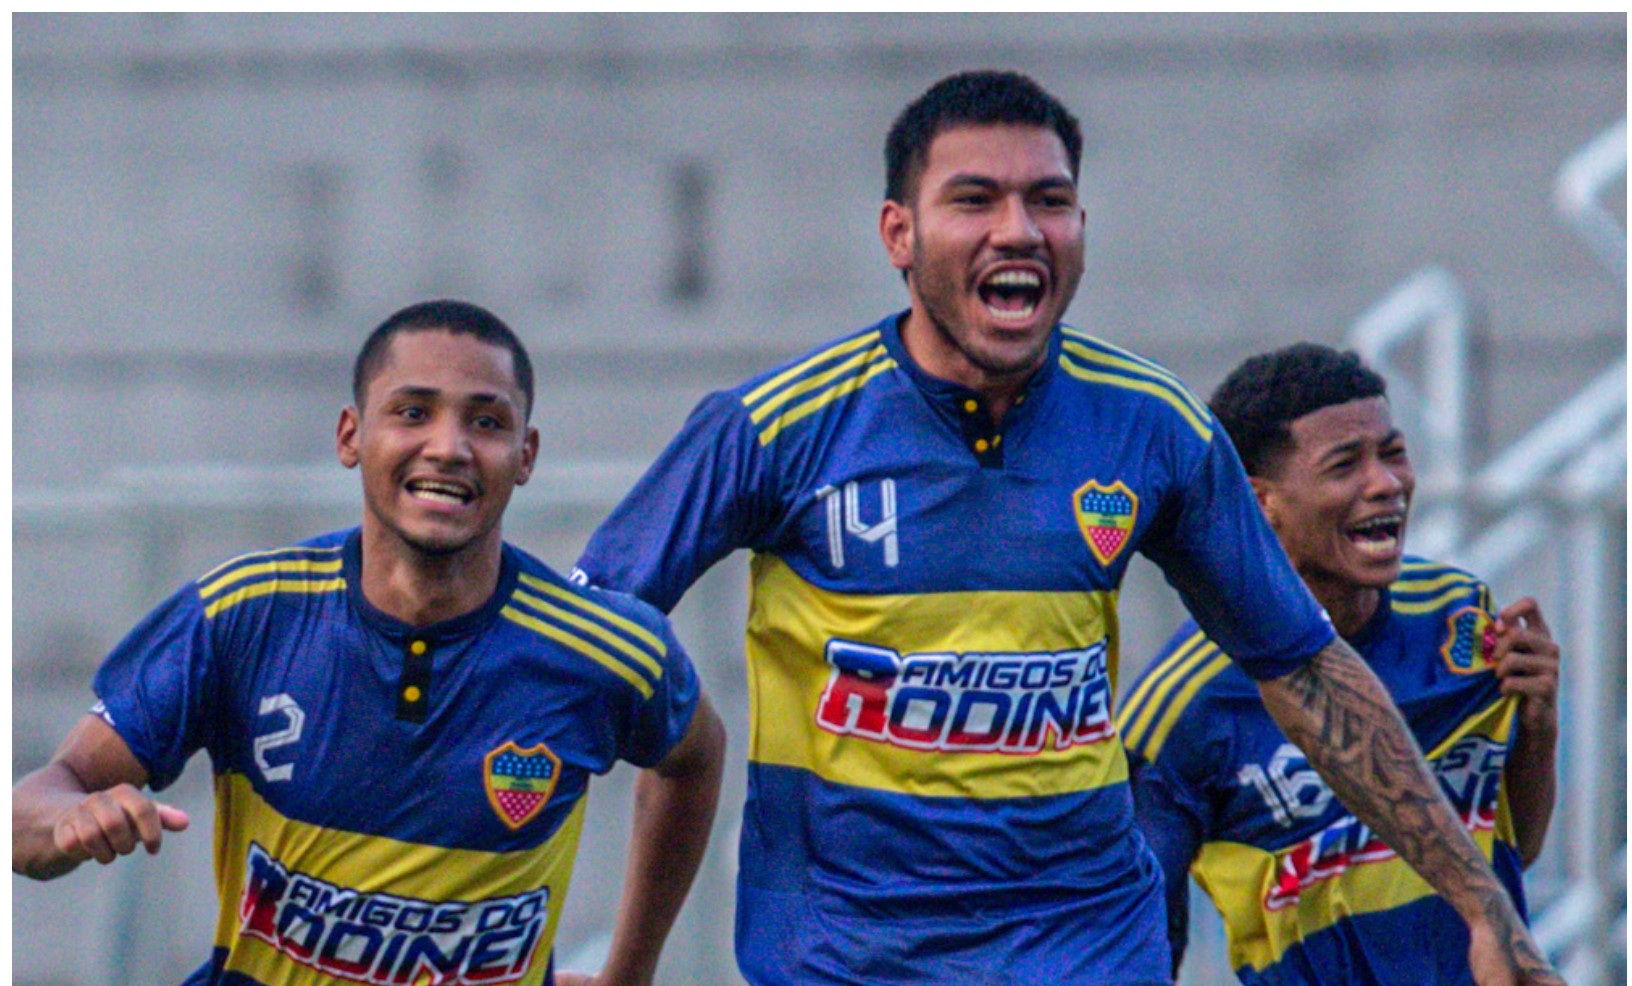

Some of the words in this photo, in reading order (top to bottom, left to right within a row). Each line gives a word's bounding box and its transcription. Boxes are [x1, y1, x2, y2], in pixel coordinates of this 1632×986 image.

[816, 477, 898, 568] 14
[902, 656, 1078, 690] AMIGOS
[253, 693, 306, 782] 2
[1237, 742, 1334, 828] 16
[242, 848, 542, 985] RODINEI
[288, 879, 468, 934] AMIGOS
[474, 893, 541, 932] DO
